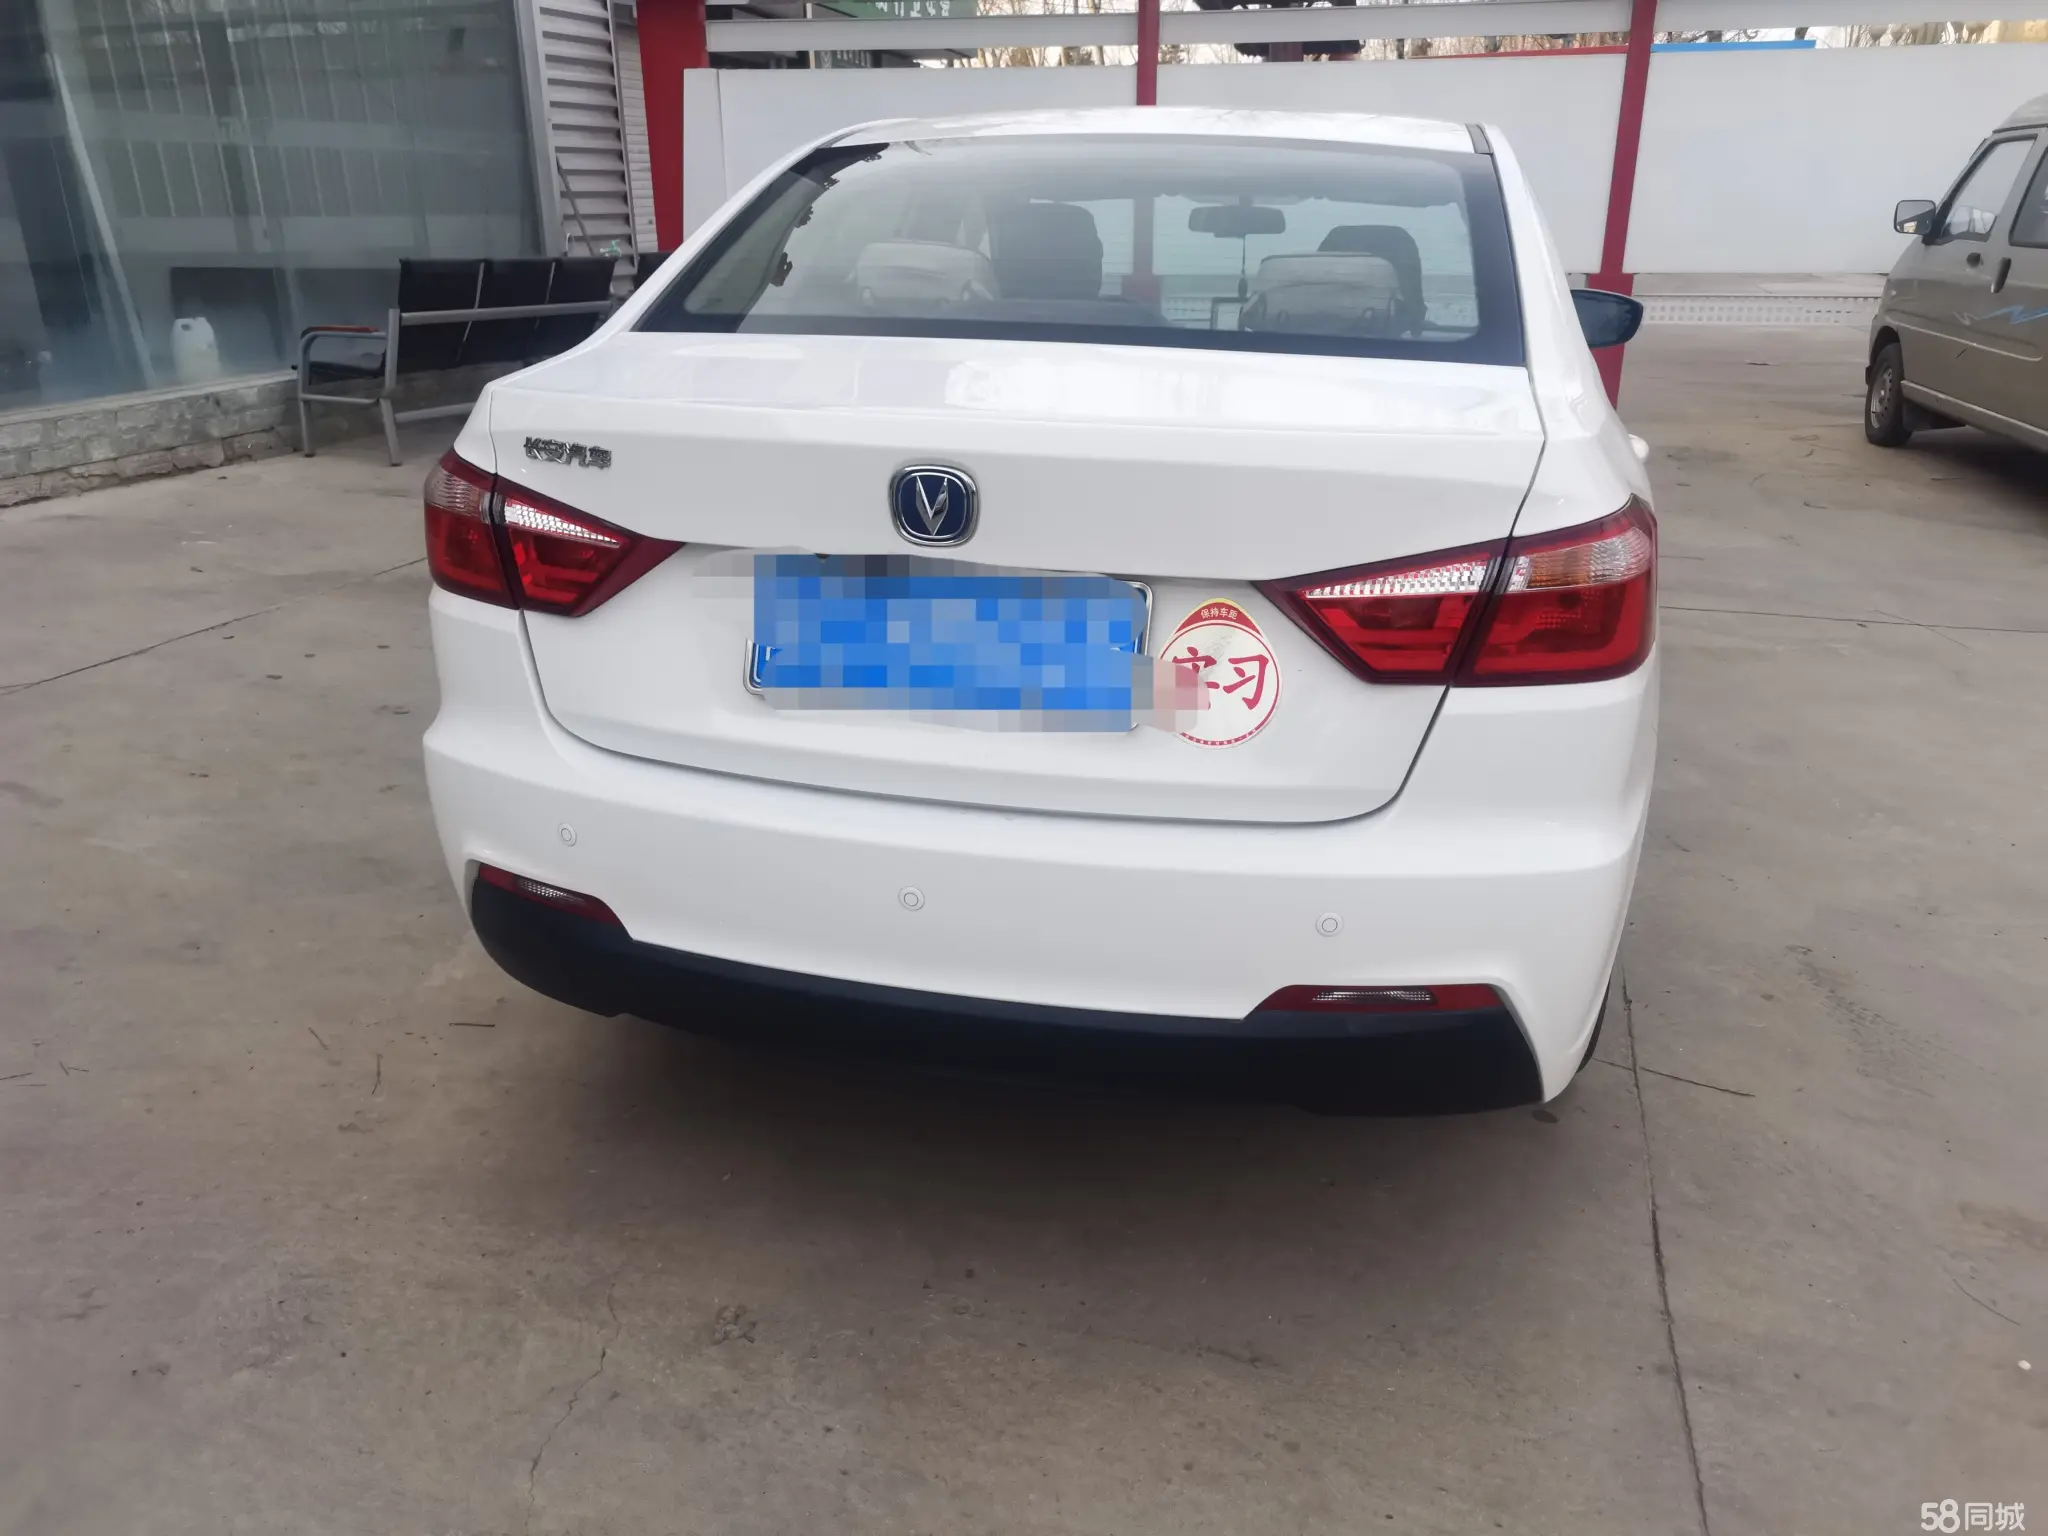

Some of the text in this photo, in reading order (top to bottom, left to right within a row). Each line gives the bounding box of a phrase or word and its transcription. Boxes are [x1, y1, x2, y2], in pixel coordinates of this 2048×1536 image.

[523, 436, 613, 470] 长安汽车
[1200, 606, 1239, 620] 保持车距
